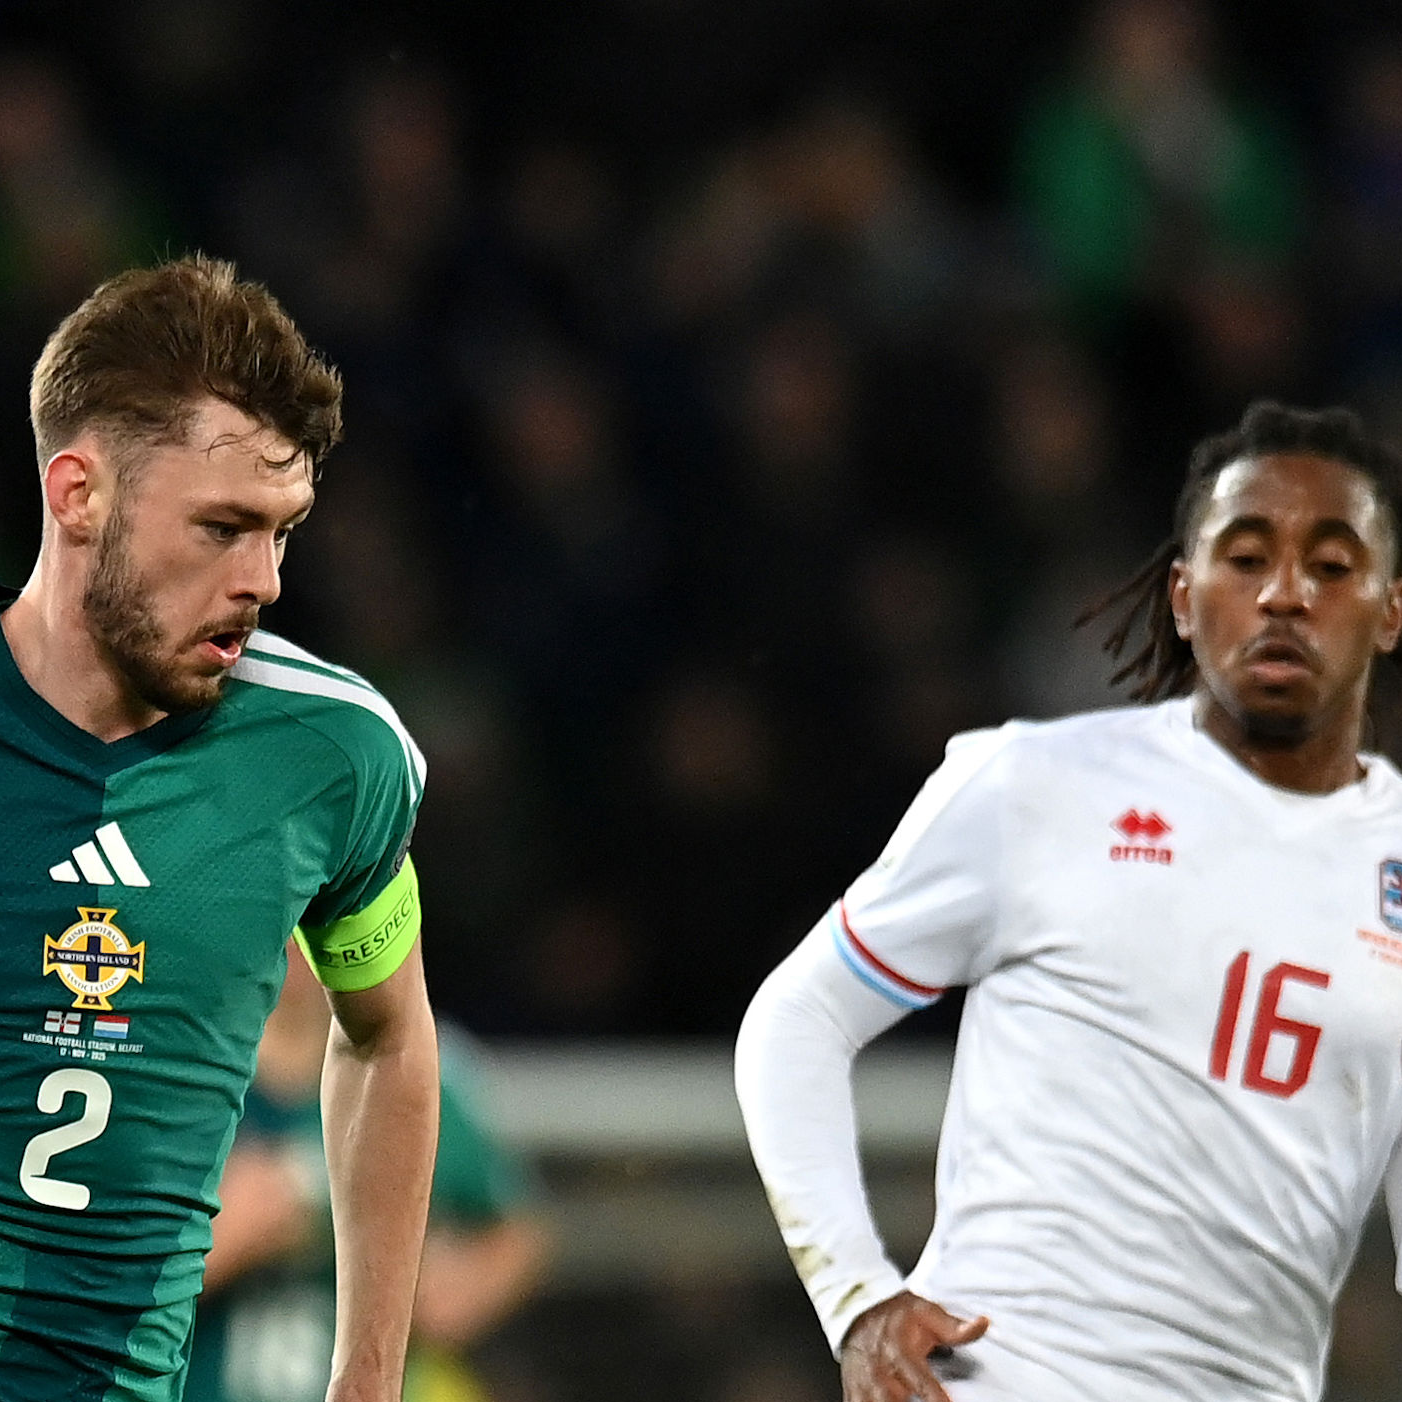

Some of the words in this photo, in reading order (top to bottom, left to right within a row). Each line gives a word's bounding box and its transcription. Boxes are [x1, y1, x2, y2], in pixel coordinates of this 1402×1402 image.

[342, 887, 415, 963] RESPECT
[65, 928, 84, 946] IRISH
[86, 925, 124, 949] FOOTBALL
[57, 952, 96, 963] NORTHERN
[97, 954, 130, 966] IRELAND
[66, 972, 120, 993] ASSOCIATION
[1209, 951, 1331, 1099] 16
[23, 1032, 54, 1046] NATIONAL
[55, 1036, 86, 1049] FOOTBALL
[118, 1043, 144, 1053] BELFAST
[72, 1049, 86, 1058] NOV
[19, 1068, 112, 1211] 2
